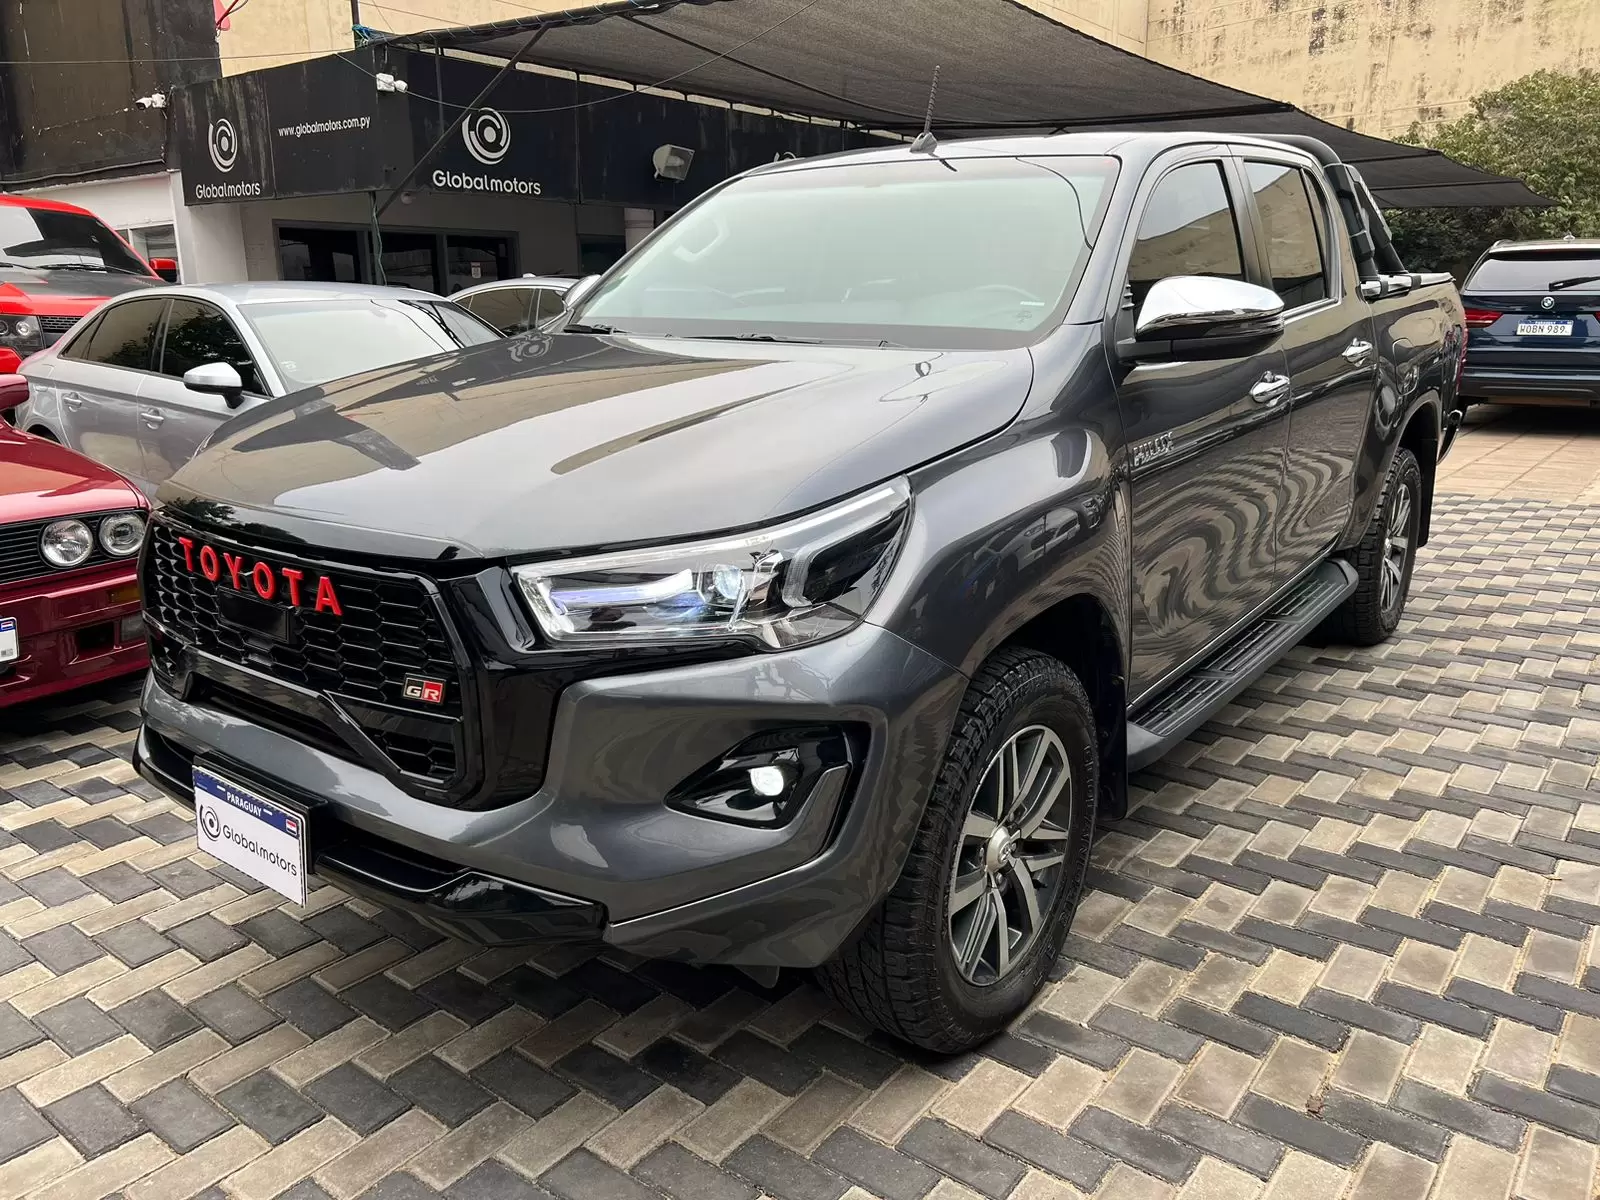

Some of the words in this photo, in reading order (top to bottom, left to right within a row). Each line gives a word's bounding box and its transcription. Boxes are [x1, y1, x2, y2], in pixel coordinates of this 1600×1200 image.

[278, 116, 371, 138] www.globalmotors.com.py
[195, 180, 261, 199] Globalmotors
[432, 169, 541, 195] Globalmotors
[178, 536, 343, 617] TOYOTA
[406, 685, 439, 701] GR
[226, 791, 262, 817] PARAGUAY
[222, 823, 298, 877] Globalmotors
